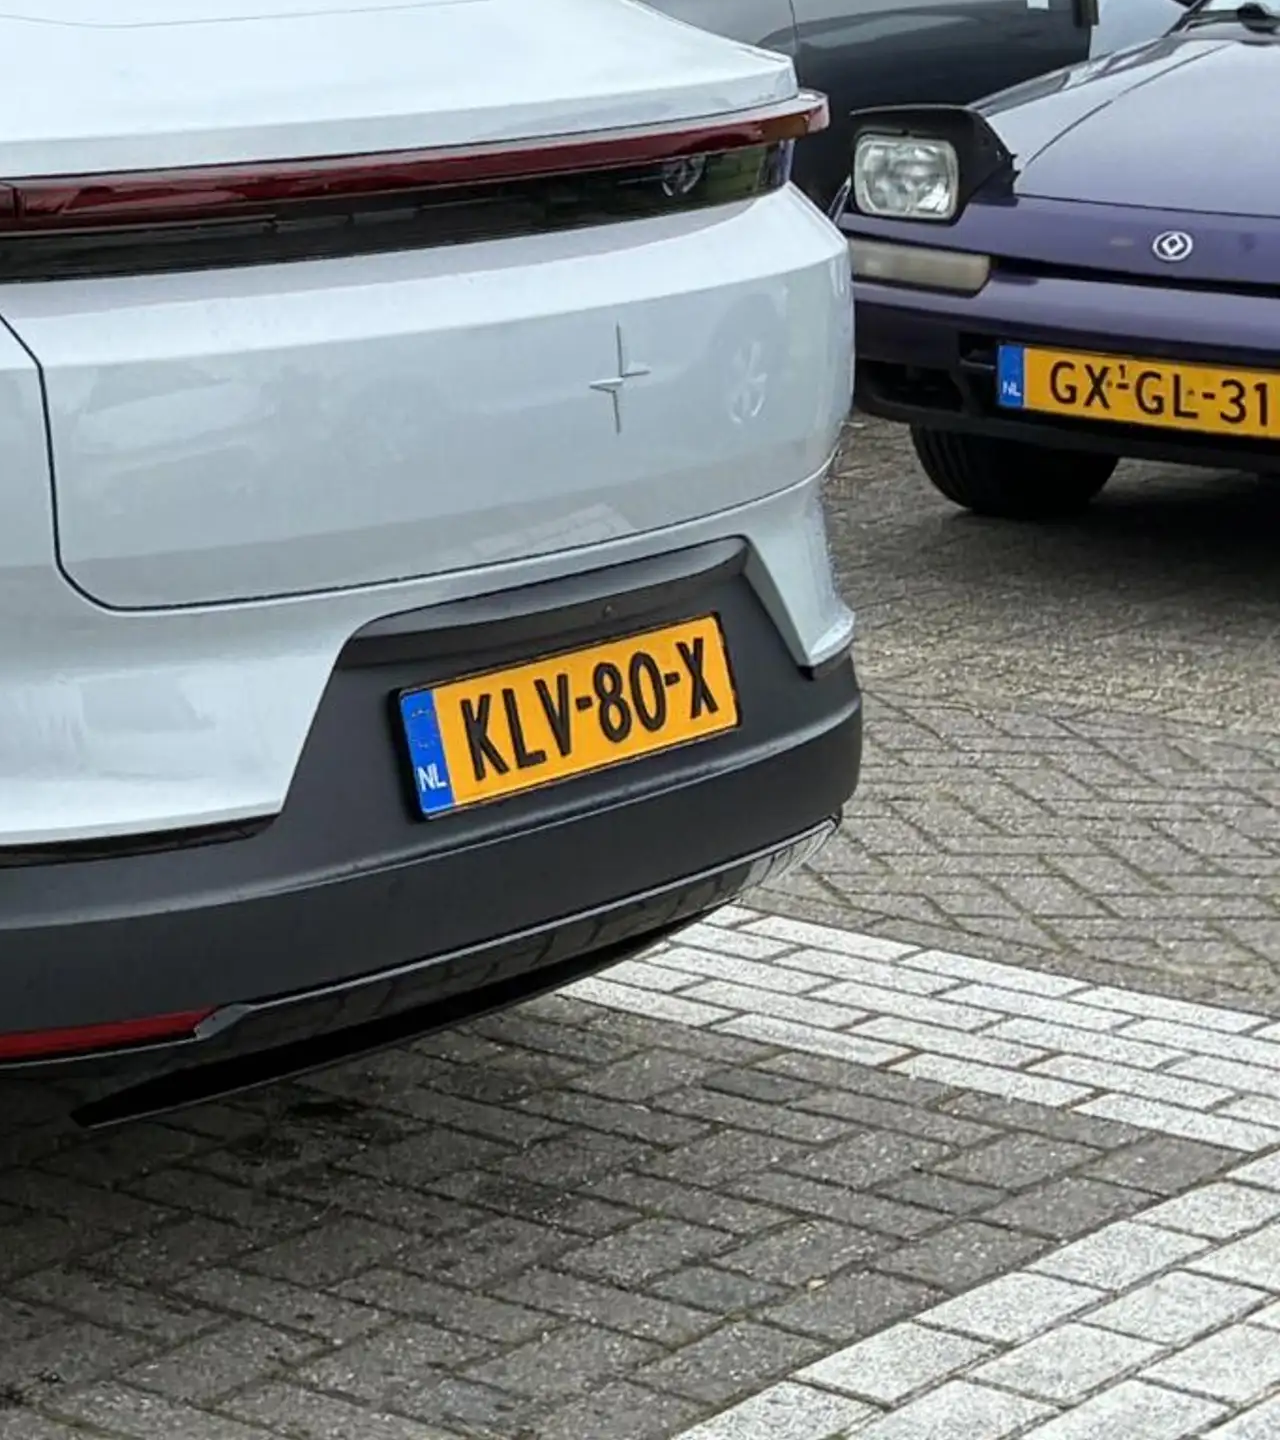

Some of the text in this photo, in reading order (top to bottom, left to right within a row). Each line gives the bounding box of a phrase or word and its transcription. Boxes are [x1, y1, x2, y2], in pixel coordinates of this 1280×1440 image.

[1002, 360, 1269, 427] NL GX-GL-31
[415, 637, 719, 792] NL KLV-80-X
